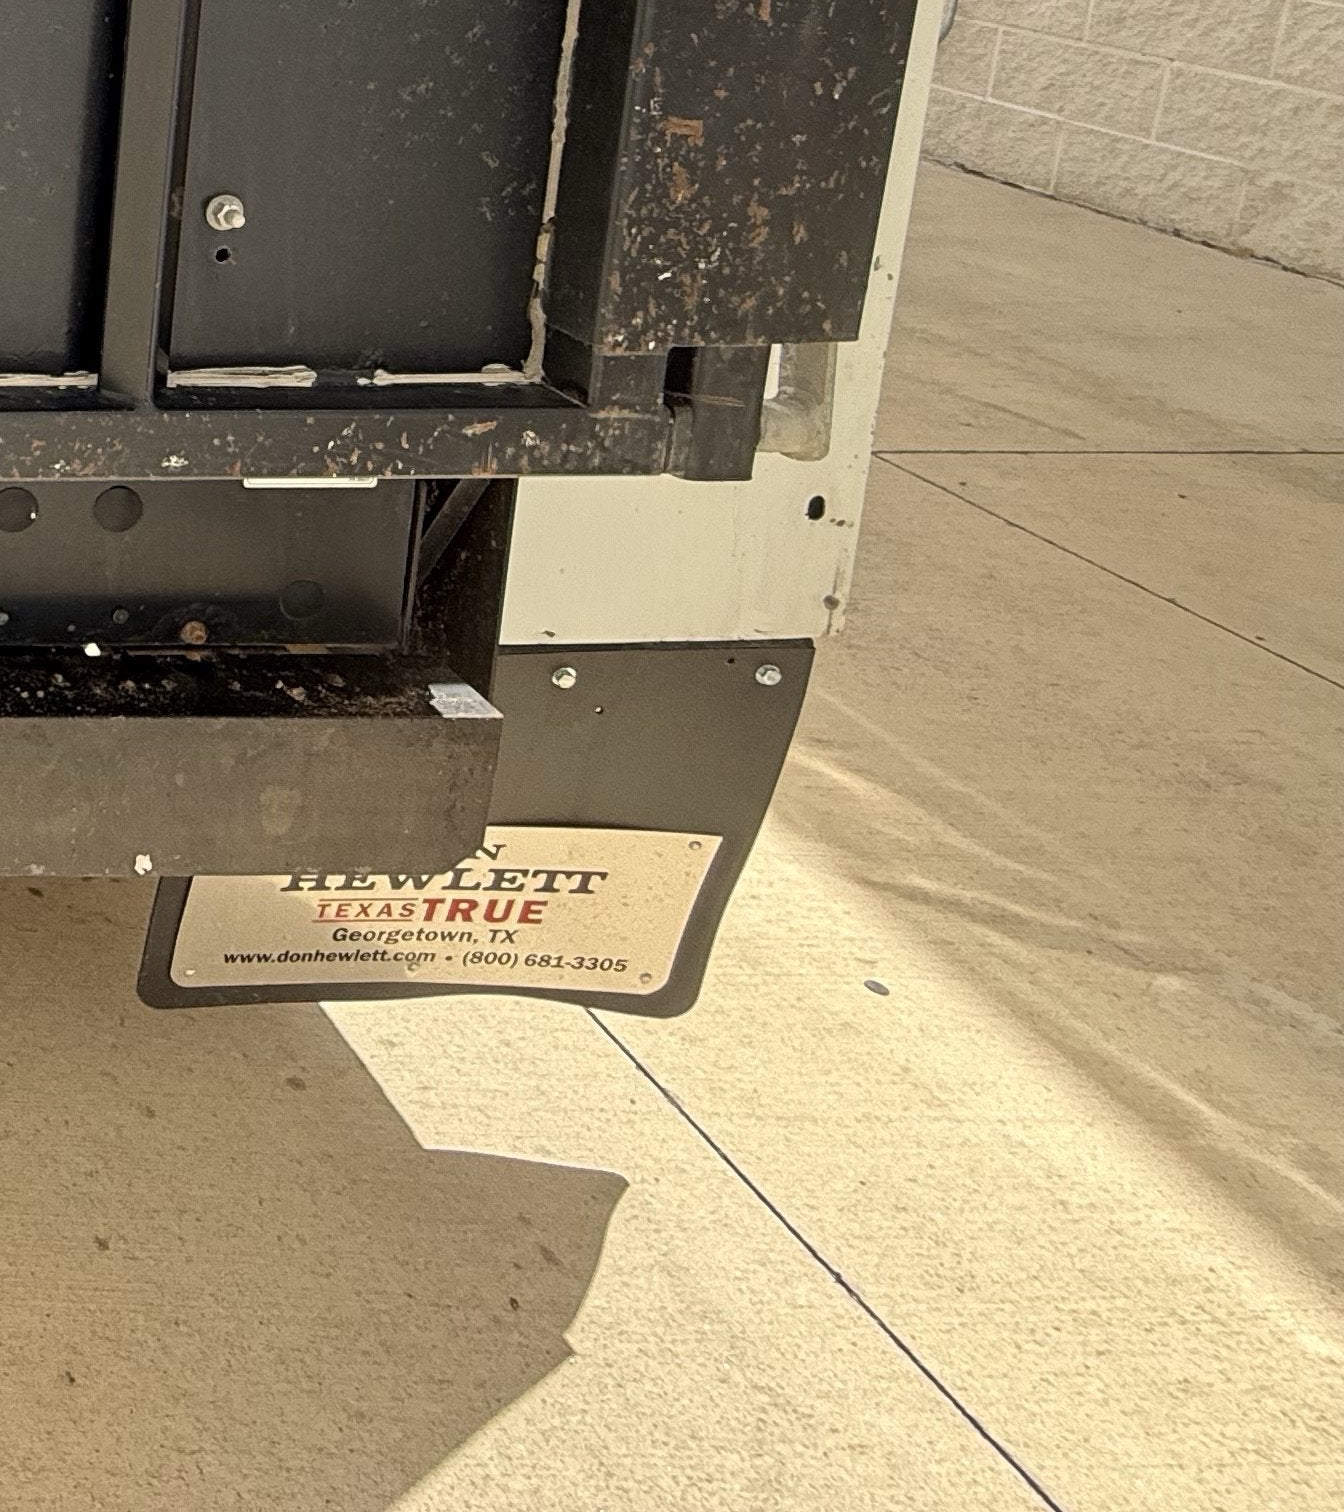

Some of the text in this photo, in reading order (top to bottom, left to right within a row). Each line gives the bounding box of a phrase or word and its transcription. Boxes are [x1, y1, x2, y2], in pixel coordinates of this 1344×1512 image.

[332, 928, 518, 944] Georgetown, TX
[223, 949, 628, 972] www.donhewlett.com (800) 681-3305
